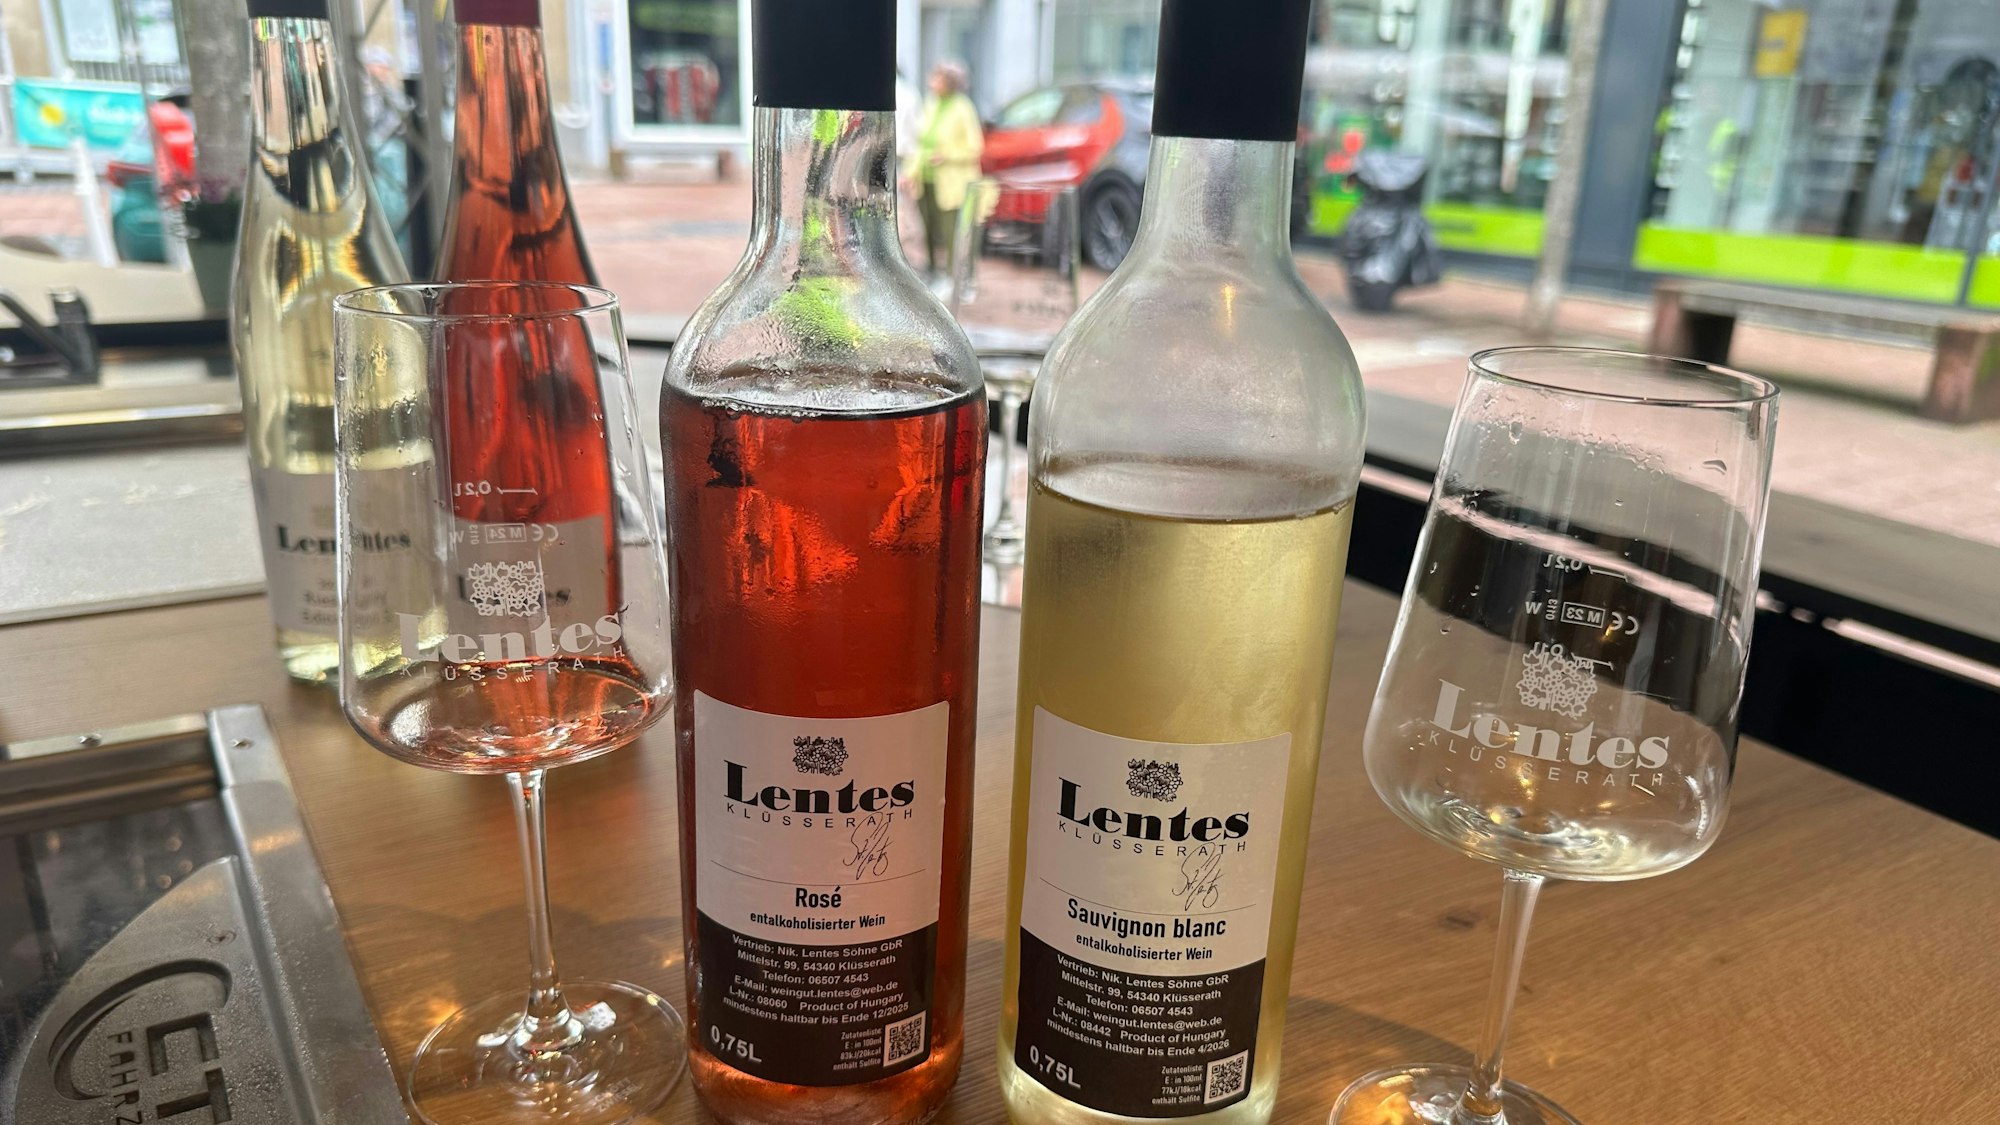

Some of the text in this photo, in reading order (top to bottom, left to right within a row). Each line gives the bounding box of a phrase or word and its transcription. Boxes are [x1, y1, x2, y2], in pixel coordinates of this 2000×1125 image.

[395, 612, 621, 664] Lentes
[400, 645, 624, 681] KLÜSSERATH
[1429, 678, 1669, 769] Lentes
[1429, 729, 1663, 787] KLÜSSERATH
[724, 760, 914, 814] Lentes
[727, 802, 912, 828] KLÜSSERATH
[1057, 776, 1249, 842] Lentes
[1058, 820, 1246, 856] KLÜSSERATH
[795, 885, 841, 908] Rosé
[750, 912, 885, 930] entalkoholisierter Wein
[1068, 897, 1226, 939] Sauvignon blanc
[732, 934, 902, 958] Vertrieb: Nik. Lentes Söhne GbR
[737, 950, 896, 971] Mittelstr. 99, 54340 Klüsserath
[1076, 934, 1212, 961] entalkoholisierter Wein
[734, 974, 898, 999] E-Mail: weingut.lentes@web.de
[762, 970, 869, 984] Telefon: 06507 4543
[1057, 954, 1229, 989] Vertrieb: Nik. Lentes Söhne GbR
[1061, 970, 1221, 1002] Mittelstr. 99, 54340 Klüsserath
[723, 996, 909, 1024] mindestens haltbar bis Ende 12/2025
[729, 985, 904, 1011] L-Nr.: 08060 Product of Hungary
[1057, 996, 1222, 1031] E-Mail: weingut.lentes@web.de
[1085, 993, 1193, 1016] Telefon: 06507 4543
[1047, 1019, 1230, 1056] mindestens haltbar bis Ende 4/2026
[1052, 1007, 1226, 1043] L-Nr.: 08442 Product of Hungary
[710, 1024, 762, 1063] 0,75L
[1029, 1045, 1081, 1088] 0,75L
